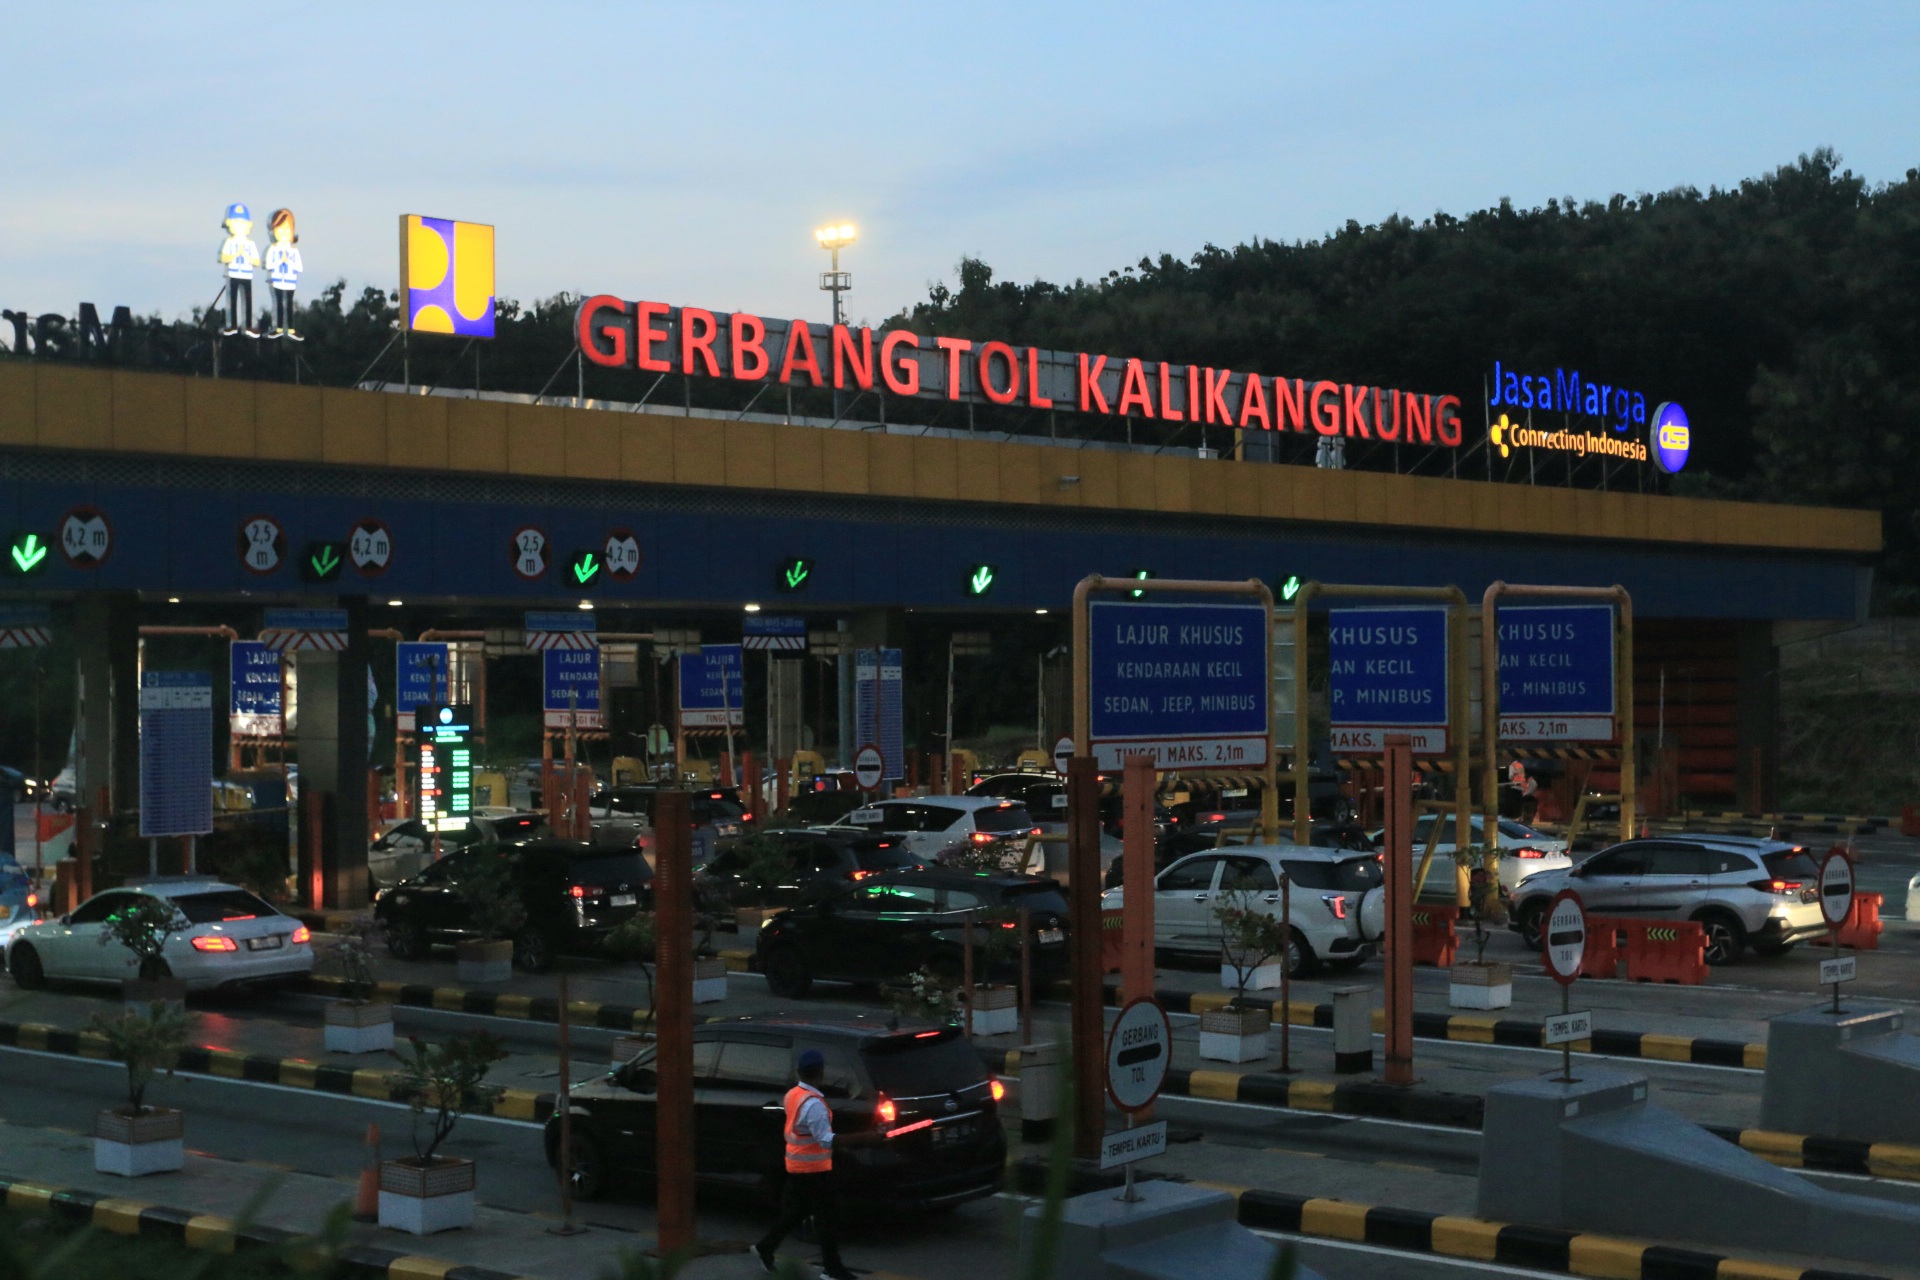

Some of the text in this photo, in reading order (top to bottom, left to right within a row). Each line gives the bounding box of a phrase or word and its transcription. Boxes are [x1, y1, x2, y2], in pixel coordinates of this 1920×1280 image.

[577, 294, 1464, 447] GERBANG TOL KALIKANGKUNG
[1510, 423, 1647, 462] Connecting Indonesia
[65, 526, 106, 548] 4,2 m
[251, 523, 271, 544] 2,5
[352, 537, 388, 558] 4,2 m
[522, 535, 539, 554] 2,5
[256, 549, 269, 566] m
[607, 545, 638, 563] 4,2 m
[525, 557, 536, 572] m
[1116, 624, 1244, 646] LAJUR KHUSUS
[558, 652, 592, 665] LAJUR
[705, 654, 735, 666] LAJUR
[1366, 659, 1416, 674] KECIL
[1529, 653, 1573, 668] KECIL
[559, 671, 599, 682] KENDARA
[1117, 661, 1243, 678] KENDARAAN KECIL
[1356, 688, 1432, 704] MINIBUS
[1523, 680, 1587, 696] MINIBUS
[1104, 694, 1256, 715] SEDAN, JEEP, MINIBUS
[1500, 721, 1569, 737] AKS. 2,1m
[1168, 745, 1208, 763] MAKS.
[1214, 744, 1245, 764] 2,1m
[1551, 913, 1582, 927] GERBANG
[1560, 949, 1574, 961] TOL
[1122, 1023, 1160, 1047] GERBANG
[1131, 1066, 1146, 1084] TOL
[1107, 1130, 1161, 1157] TEMPEL KARTU
